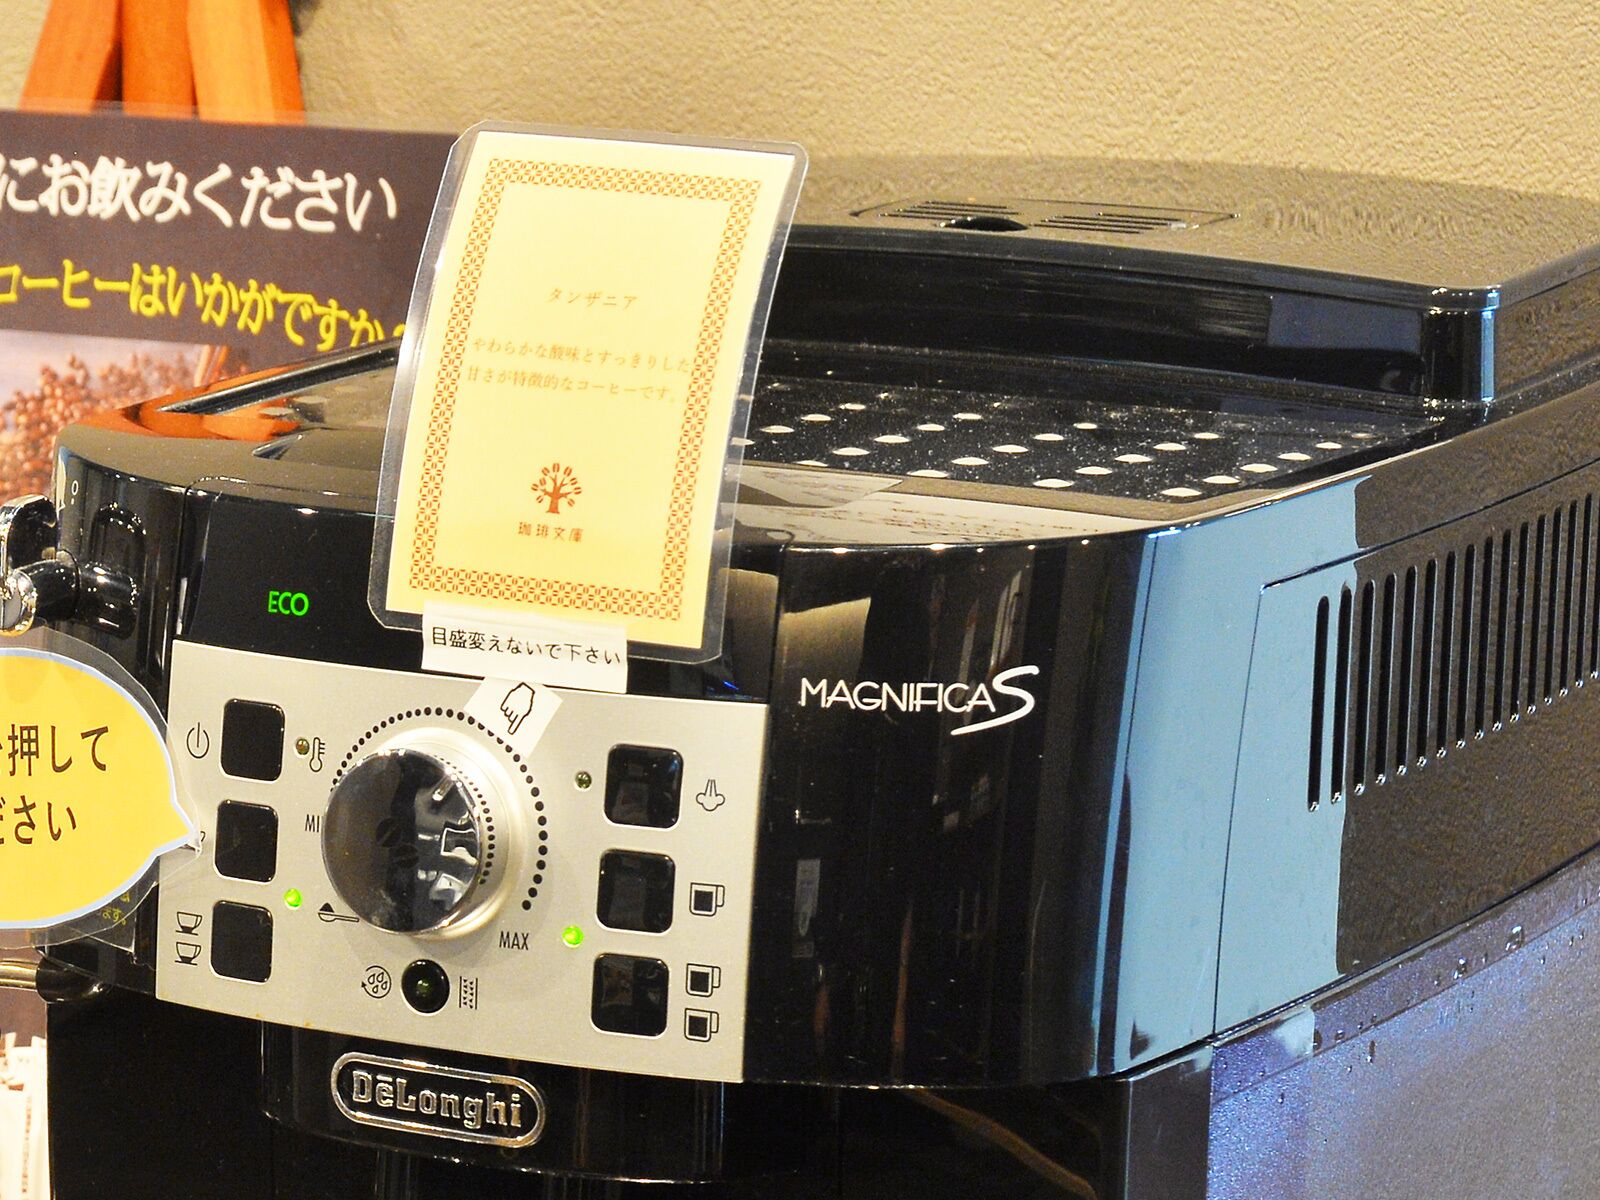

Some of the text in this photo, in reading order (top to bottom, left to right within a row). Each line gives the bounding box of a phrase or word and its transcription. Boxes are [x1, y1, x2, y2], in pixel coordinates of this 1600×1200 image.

[549, 287, 638, 309] タンザニア
[517, 521, 585, 543] 珈琲文庫
[268, 590, 310, 617] ECO
[431, 626, 622, 665] 目盛変えないで下さい
[798, 677, 997, 714] MAGNIFICA
[304, 814, 323, 833] MI
[499, 931, 529, 951] MAX
